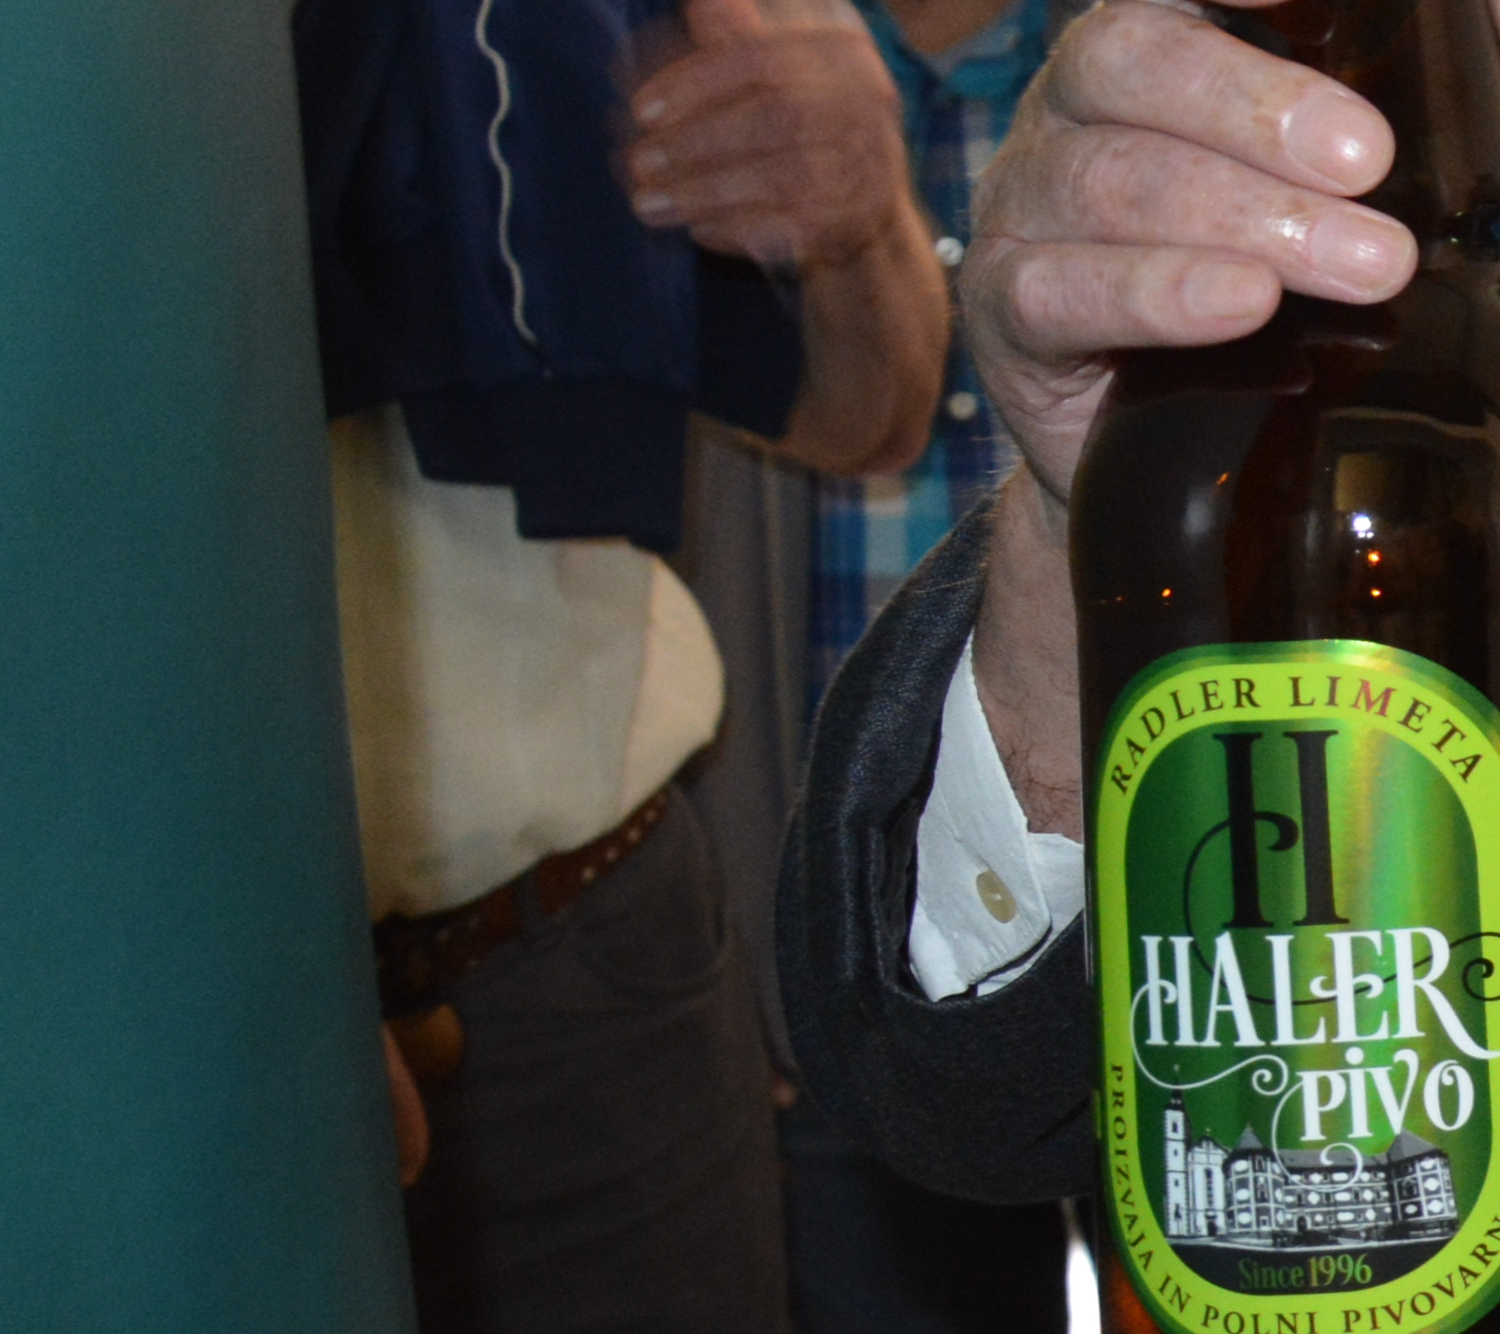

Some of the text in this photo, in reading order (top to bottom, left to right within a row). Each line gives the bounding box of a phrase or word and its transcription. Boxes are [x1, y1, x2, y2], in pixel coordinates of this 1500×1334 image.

[1110, 675, 1484, 795] RADLER LIMETA
[1109, 1063, 1154, 1271] PROIZVAJA
[1157, 1275, 1192, 1315] IN
[1238, 1252, 1373, 1289] Since 1996
